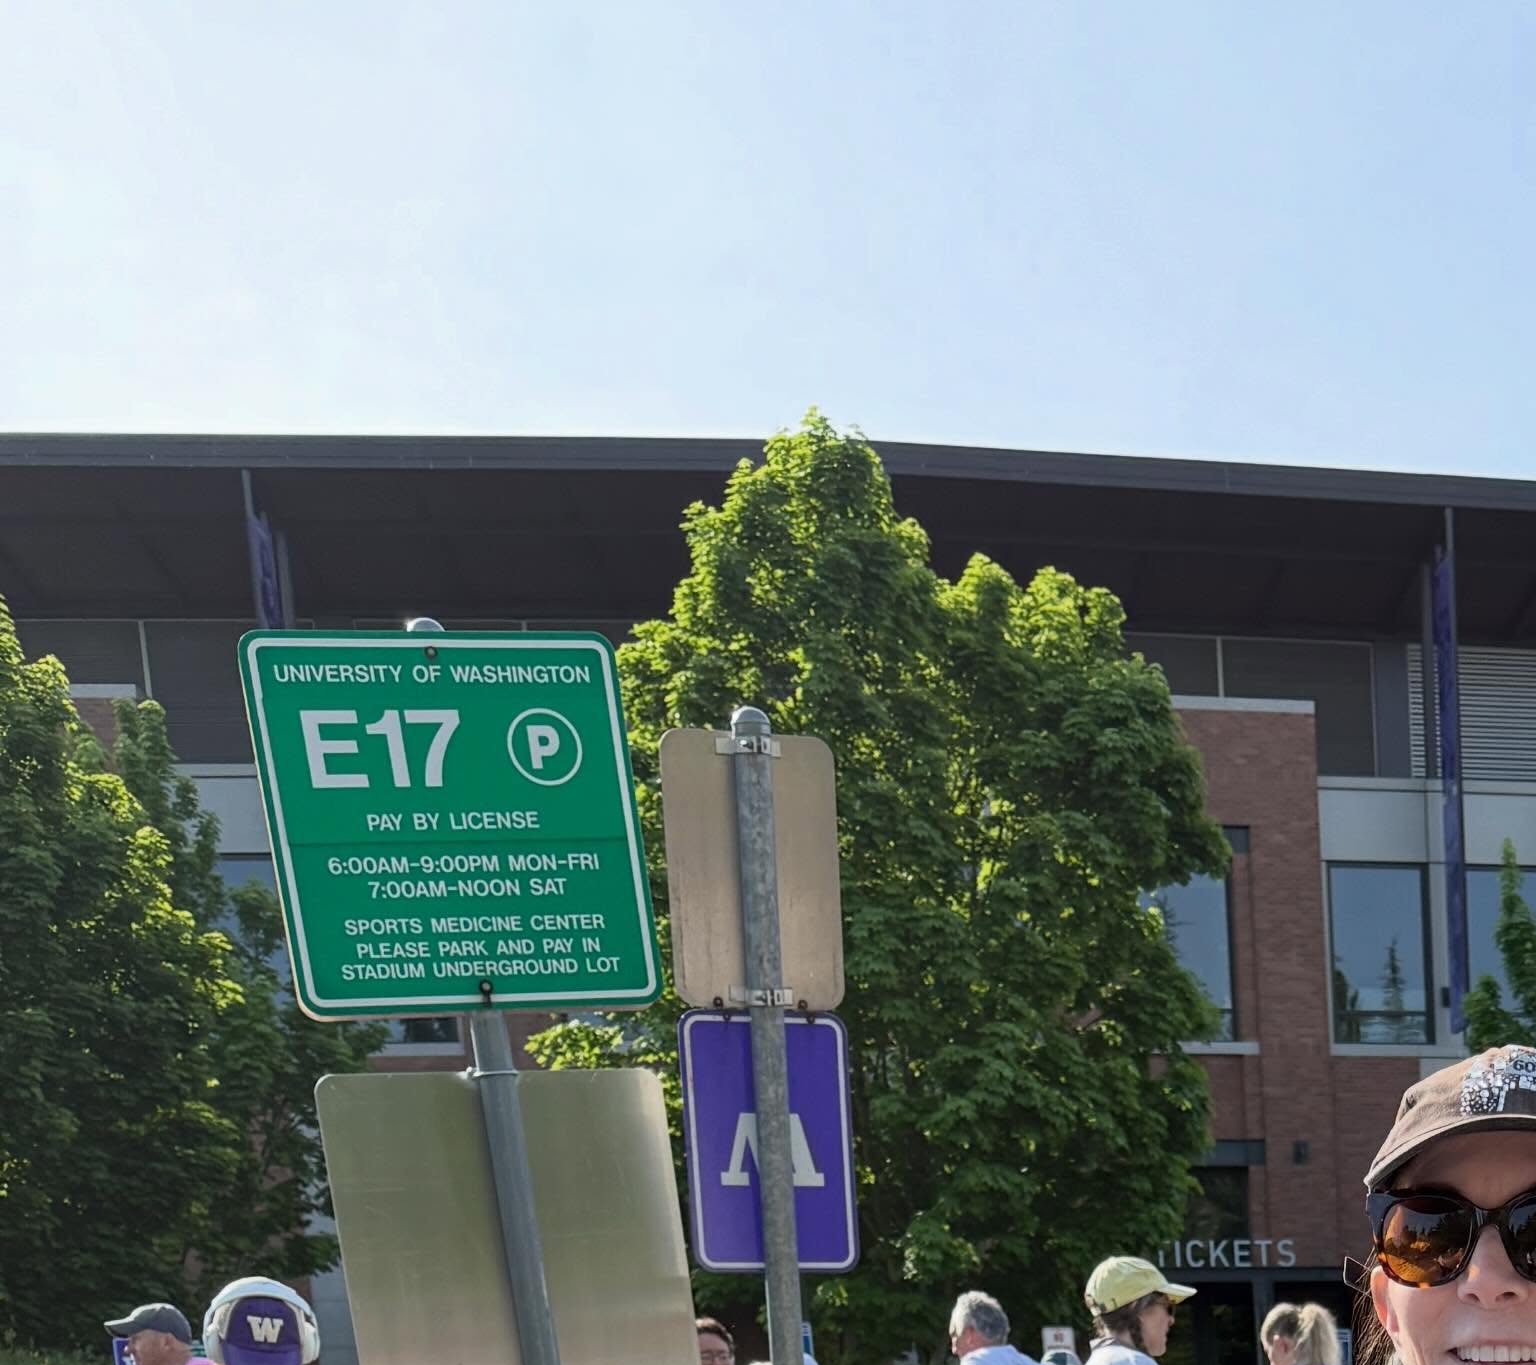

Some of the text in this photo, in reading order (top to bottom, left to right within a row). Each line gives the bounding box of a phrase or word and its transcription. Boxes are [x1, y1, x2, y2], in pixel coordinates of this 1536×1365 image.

[273, 664, 591, 683] UNIVERSITY OF WASHINGTON
[299, 709, 561, 789] E17 P
[366, 811, 541, 832] PAY BY LICENSE
[327, 852, 600, 875] 6:00AM-9:00PM MON-FRI
[367, 877, 567, 899] 7:00AM-NOON SAT
[344, 913, 605, 935] SPORTS MEDICINE CENTER
[356, 937, 601, 959] PLEASE PARK AND PAY IN
[341, 957, 620, 981] STADIUM UNDERGROUND LOT
[1513, 1059, 1536, 1073] 60
[246, 1315, 285, 1344] W
